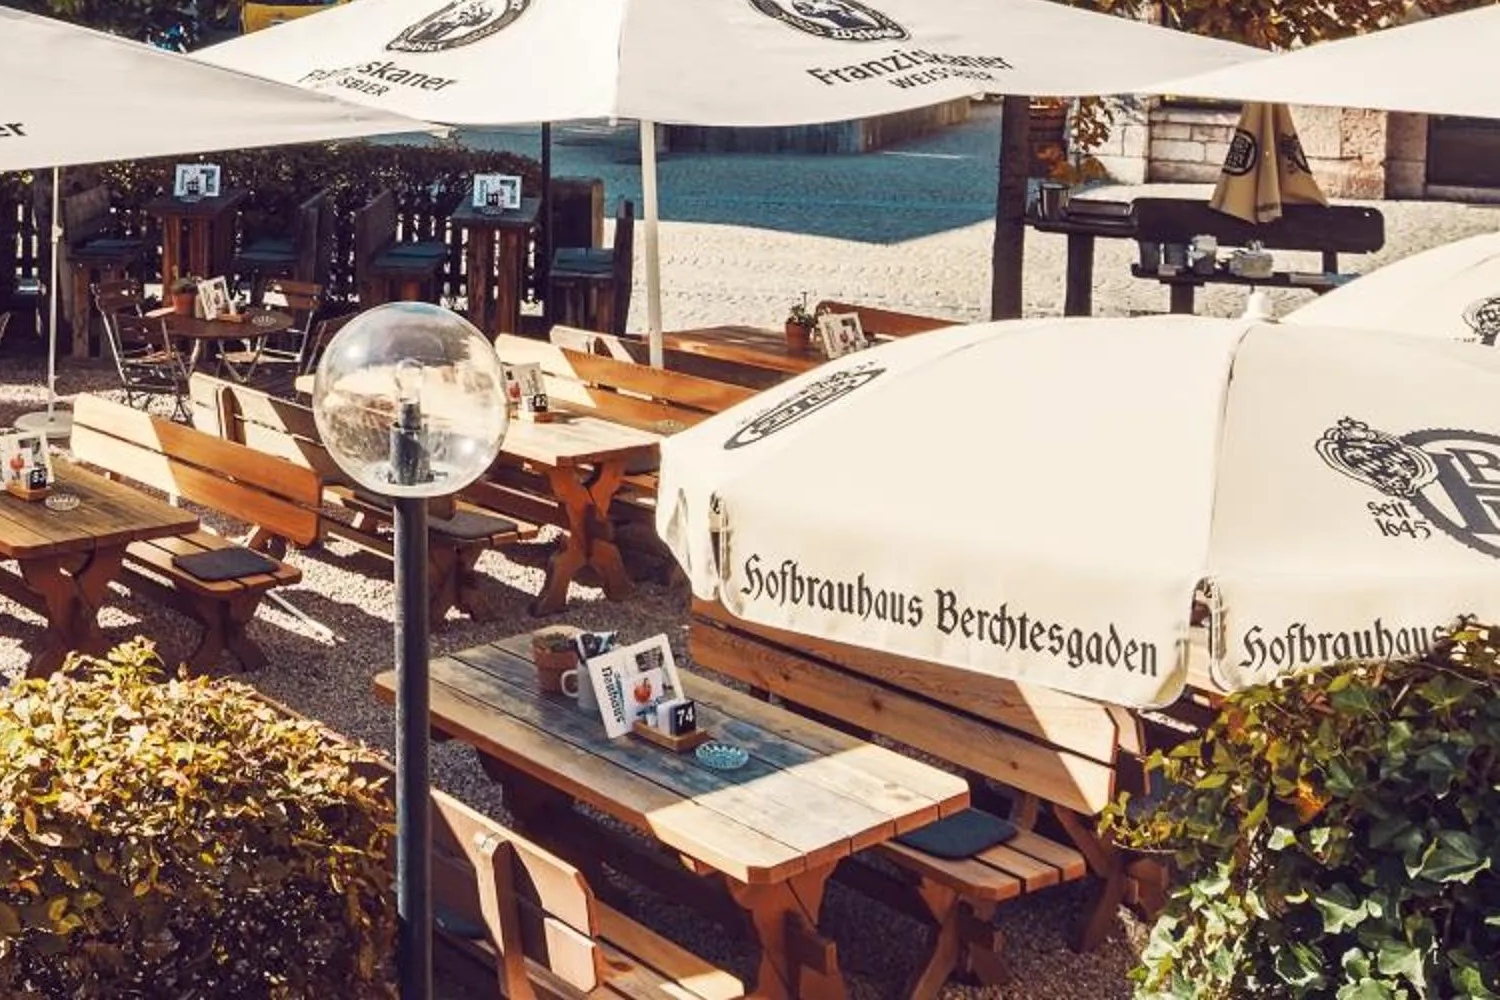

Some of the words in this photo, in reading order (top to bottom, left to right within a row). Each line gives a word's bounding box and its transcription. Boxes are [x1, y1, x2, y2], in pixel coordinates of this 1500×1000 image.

[1374, 517, 1431, 541] 1645
[740, 553, 924, 629] Hofbrauhaus
[934, 588, 1158, 677] Berchtesgaden
[676, 705, 694, 727] 74
